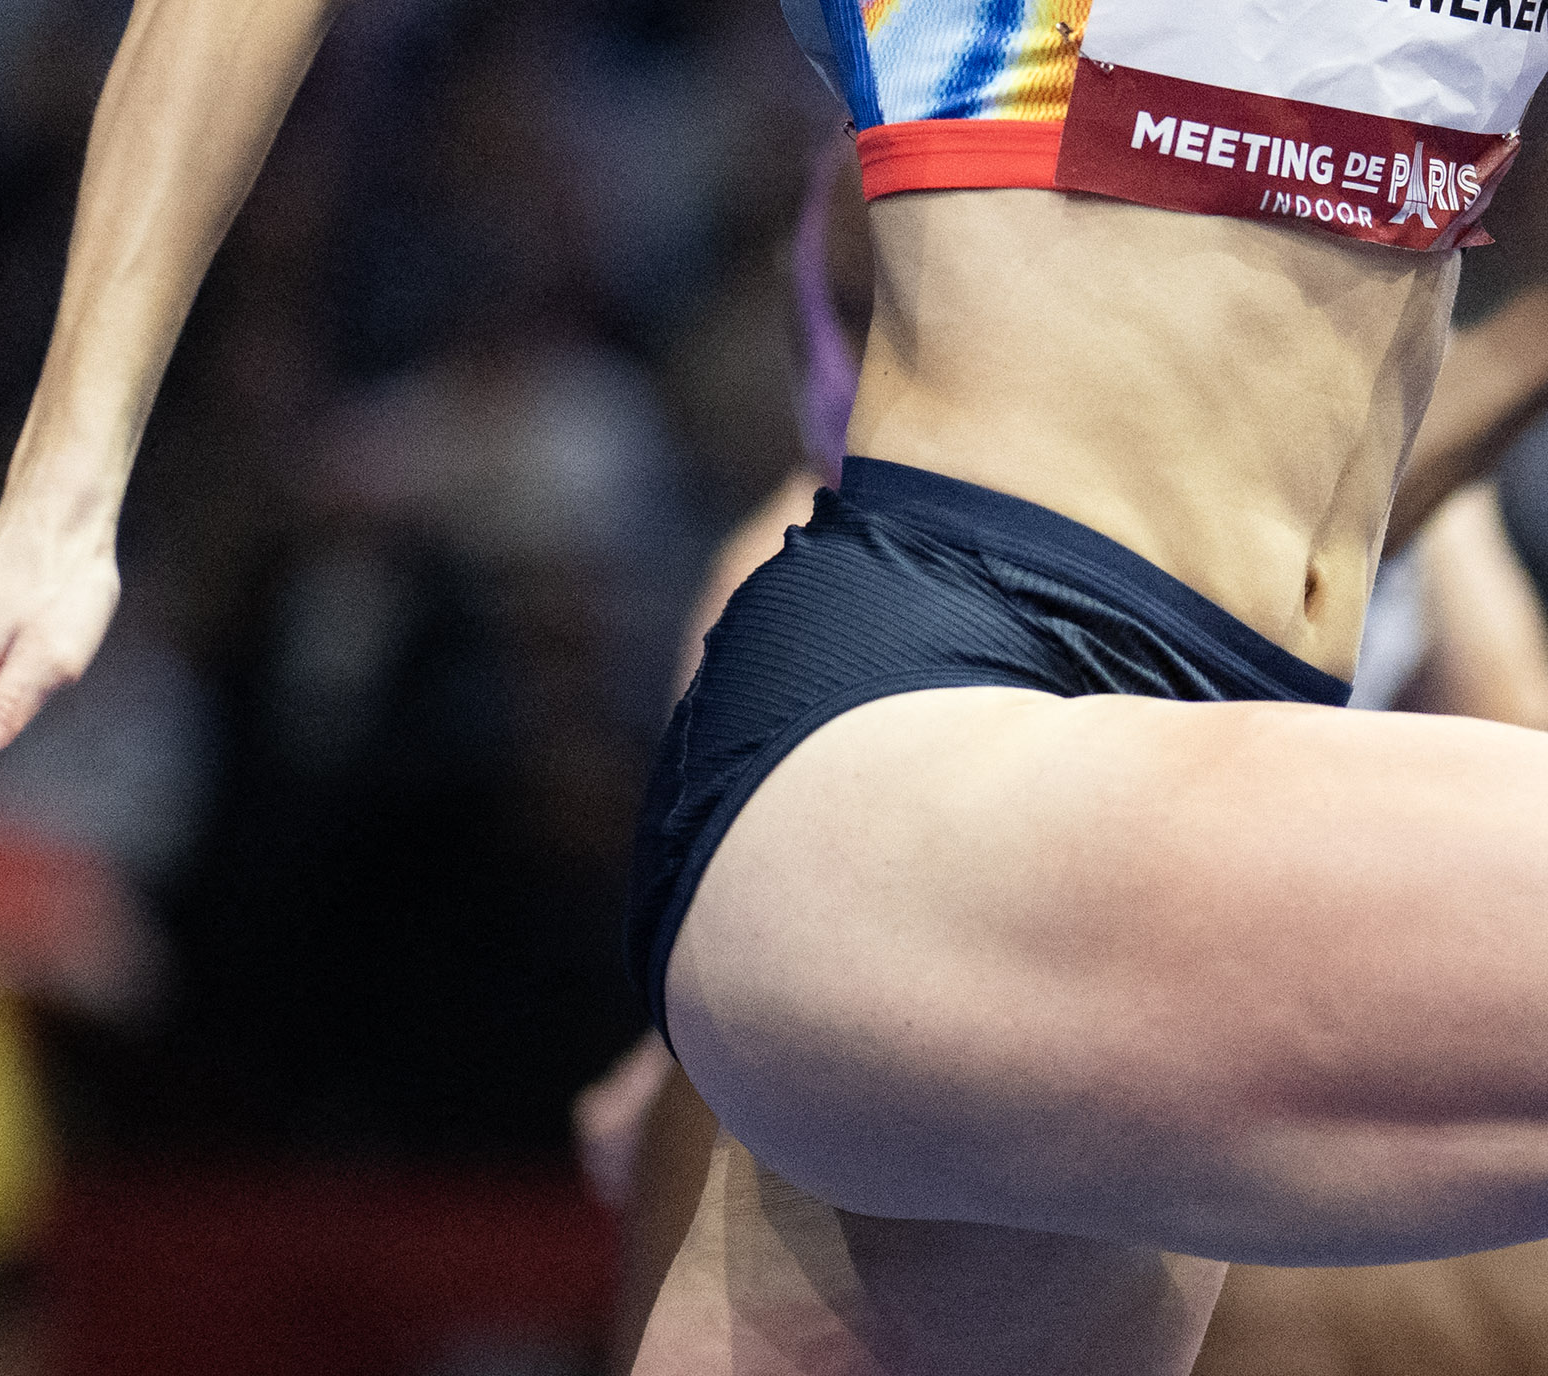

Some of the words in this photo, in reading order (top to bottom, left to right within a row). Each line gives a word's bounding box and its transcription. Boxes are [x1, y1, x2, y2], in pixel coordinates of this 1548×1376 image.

[1131, 111, 1334, 185] MEETING
[1343, 151, 1387, 184] DE
[1388, 141, 1482, 229] PARIS
[1259, 189, 1374, 229] INDOOR
